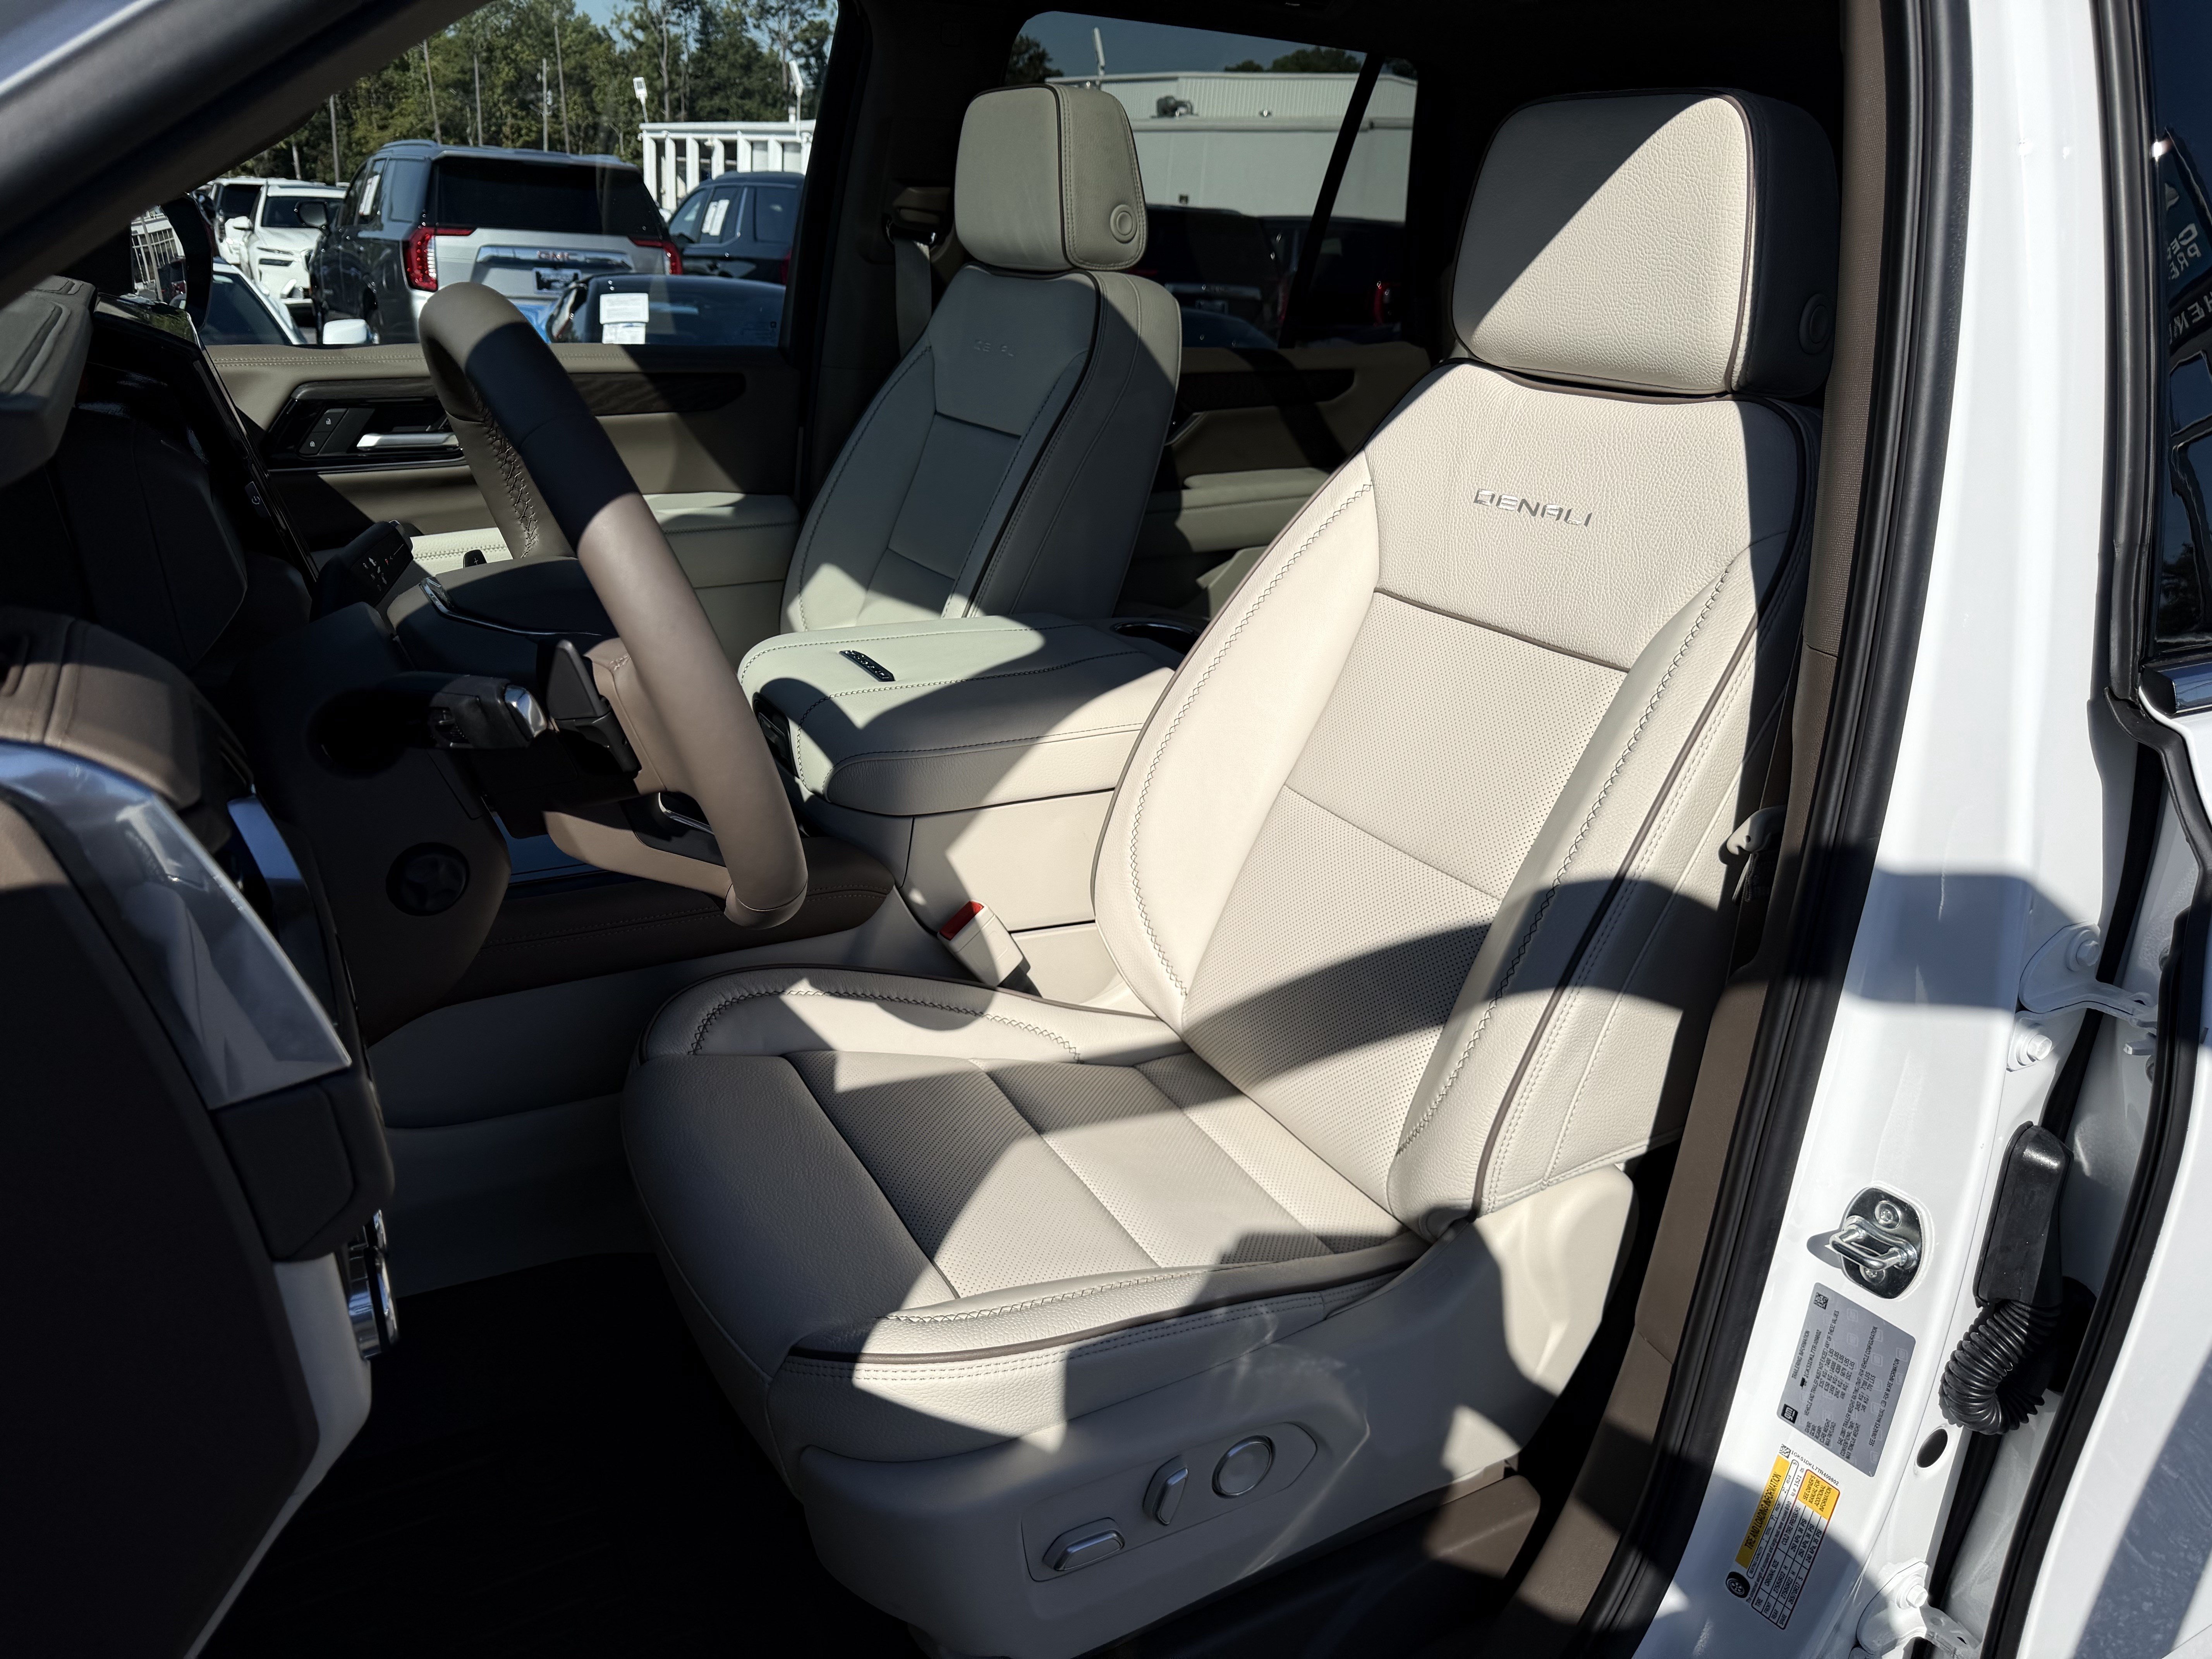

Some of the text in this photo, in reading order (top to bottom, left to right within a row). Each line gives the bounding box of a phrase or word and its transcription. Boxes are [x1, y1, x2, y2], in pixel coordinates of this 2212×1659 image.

[1473, 488, 1592, 527] DENALI
[1791, 1331, 1810, 1379] TRAILERING INFORMATION
[1810, 1379, 1819, 1394] TRAILER
[1827, 1323, 1836, 1336] THESE
[1842, 1413, 1851, 1428] TRAILER
[1794, 1475, 1802, 1487] 1521
[1808, 1488, 1818, 1504] MANUAL
[1814, 1485, 1826, 1507] ADDITIONAL
[1744, 1473, 1781, 1550] TIRE AND LOADING INFORMATION
[1819, 1486, 1832, 1512] INFORMATION
[1754, 1507, 1801, 1607] TIRE ORIGINAL SIZE COLD TIRE PRESSURE
